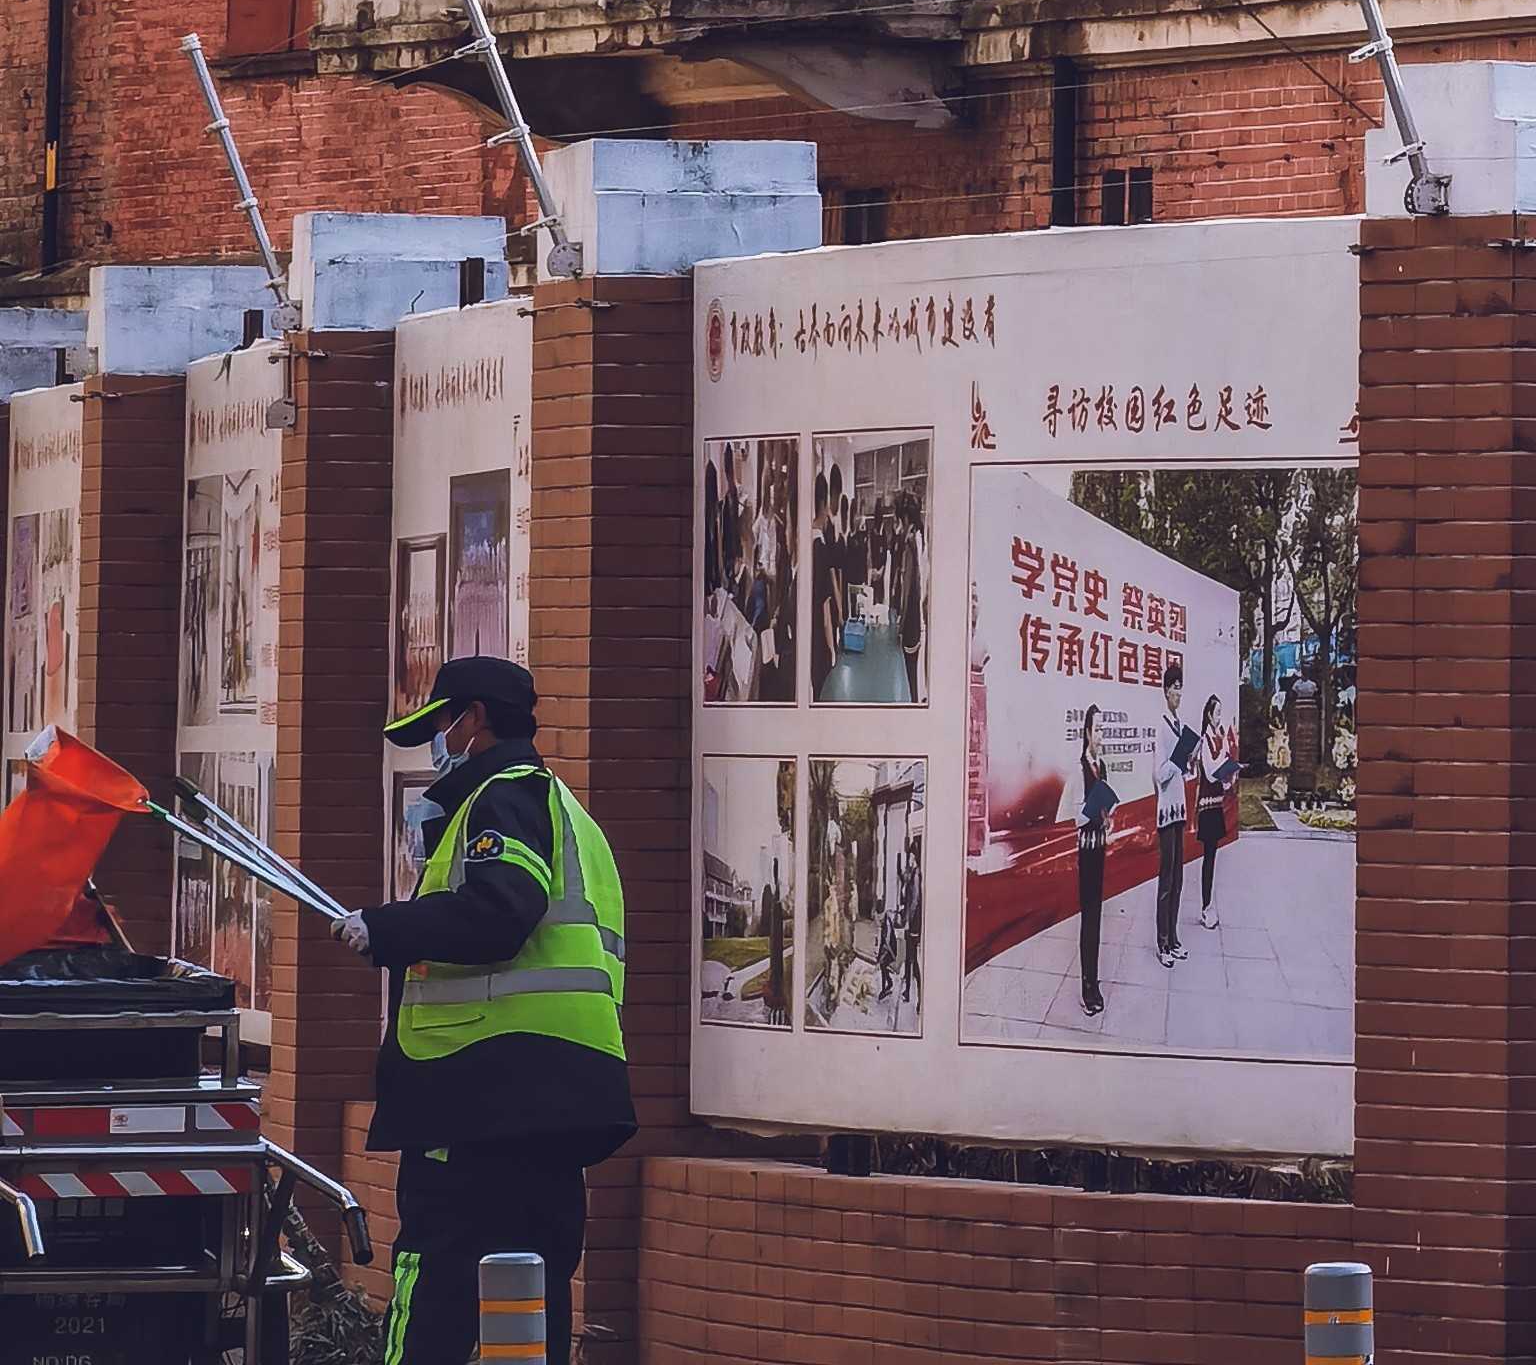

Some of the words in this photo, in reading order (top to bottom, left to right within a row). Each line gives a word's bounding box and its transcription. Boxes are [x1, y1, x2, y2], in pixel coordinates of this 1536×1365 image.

[1042, 383, 1273, 439] 寻访校园红色足迹
[1011, 536, 1109, 621] 学党史
[56, 1316, 105, 1334] 2021
